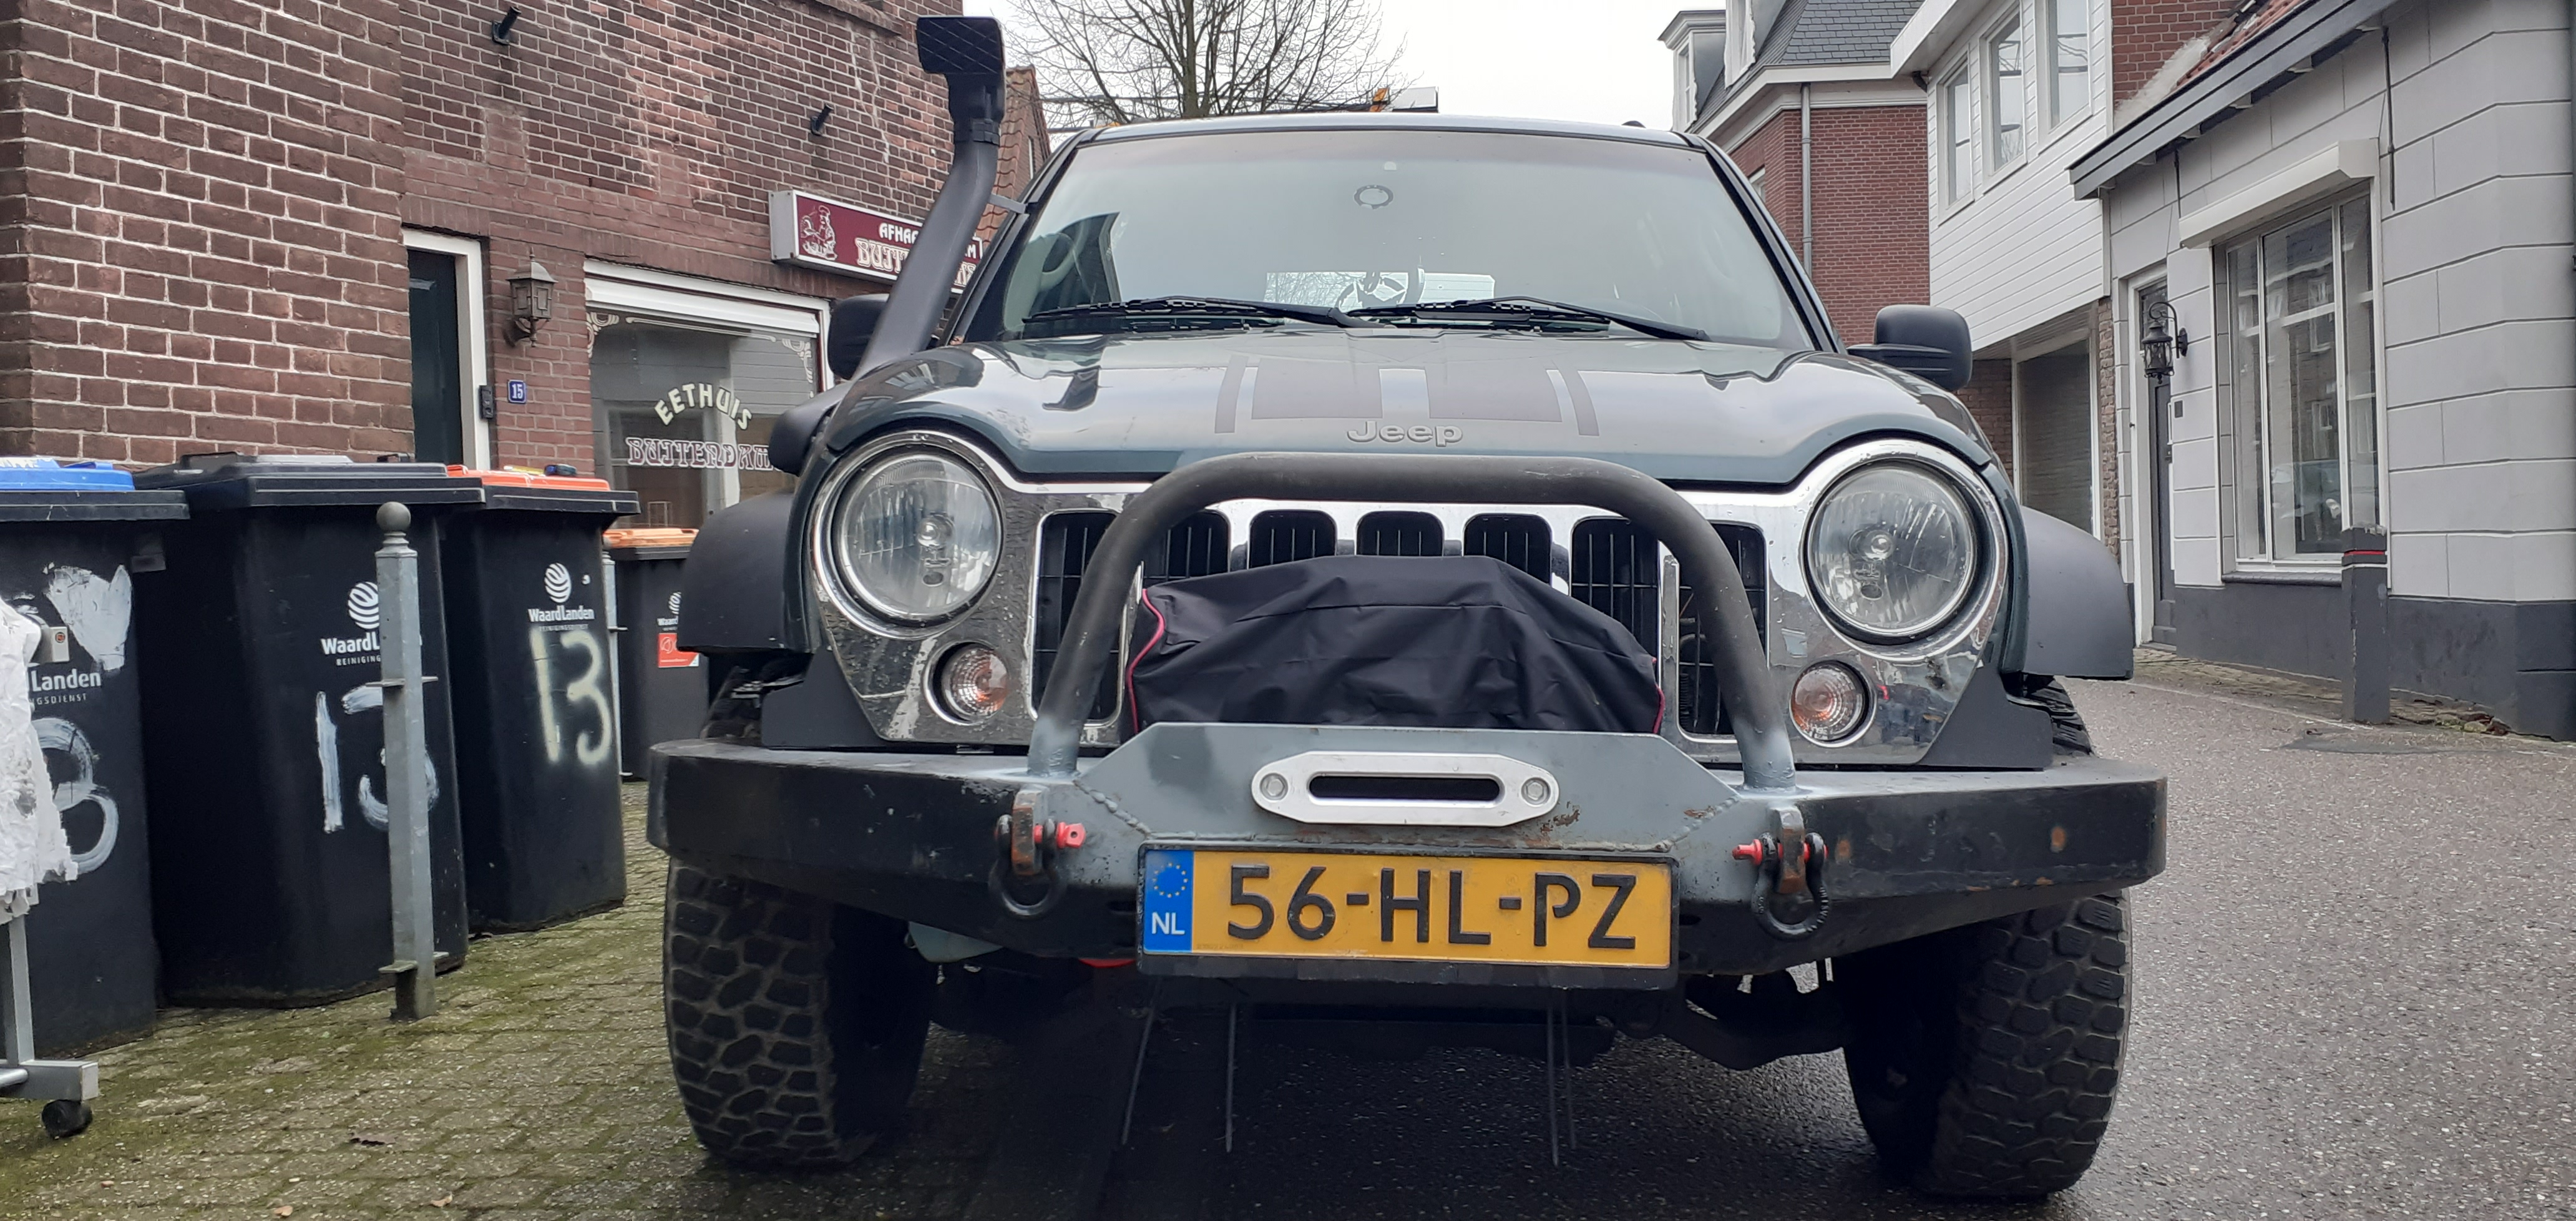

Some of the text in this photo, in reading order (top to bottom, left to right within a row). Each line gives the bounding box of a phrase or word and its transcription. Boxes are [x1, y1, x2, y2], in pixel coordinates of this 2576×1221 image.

[512, 383, 524, 399] 15
[655, 383, 753, 430] EETHUIS
[1347, 420, 1463, 447] Jeep
[528, 605, 595, 622] WaardLanden
[320, 632, 381, 655] WaardL
[336, 655, 381, 666] REINIGING
[27, 667, 102, 692] Landen
[529, 624, 612, 766] 13
[1227, 864, 1637, 950] 56-HL-PZ
[1151, 911, 1185, 936] NL
